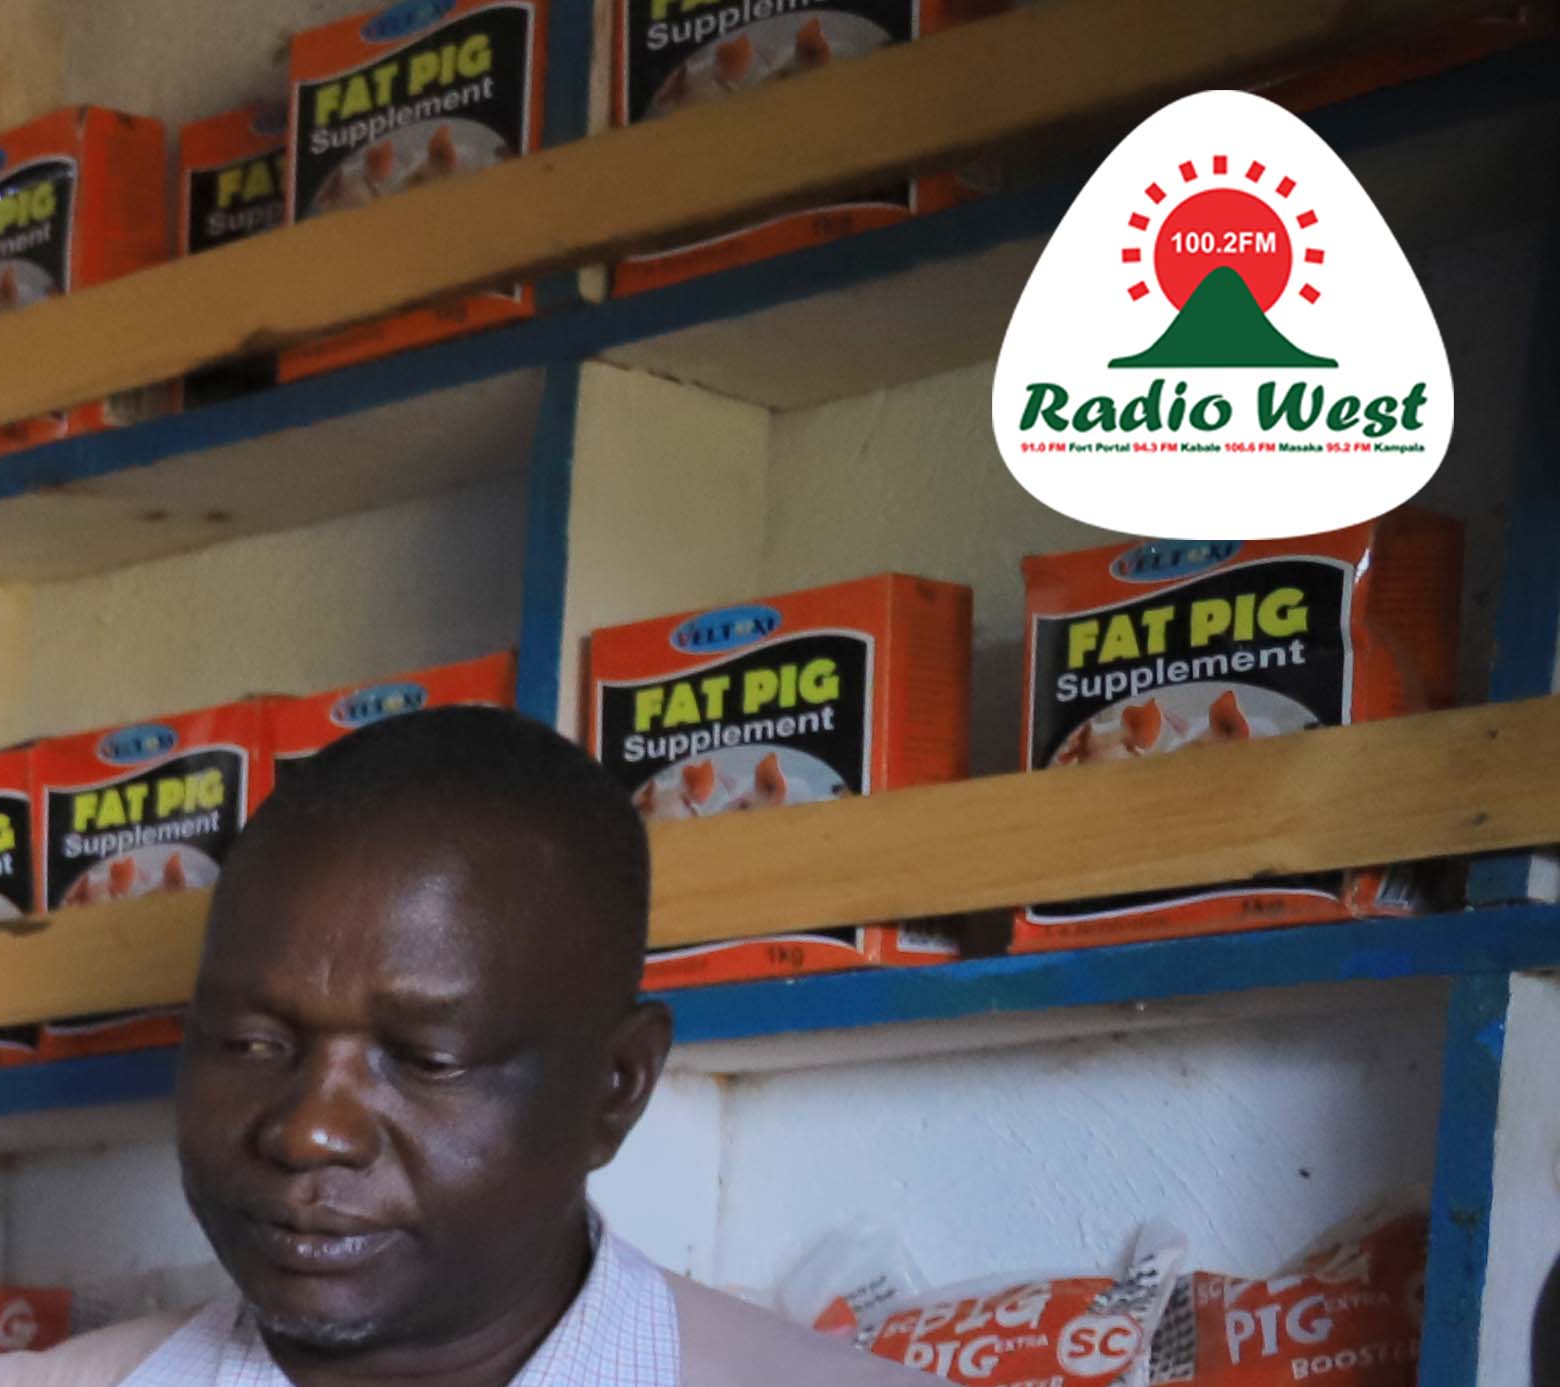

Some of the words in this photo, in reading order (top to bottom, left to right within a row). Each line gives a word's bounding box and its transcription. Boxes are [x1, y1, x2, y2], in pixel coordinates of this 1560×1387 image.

[315, 62, 399, 128] FAT
[407, 33, 493, 97] PIG
[310, 76, 496, 156] Supplement
[1067, 604, 1176, 671] FAT
[1189, 586, 1310, 649] PIG
[633, 674, 732, 734] FAT
[741, 657, 840, 716] PIG
[1056, 639, 1306, 703] Supplement
[622, 705, 836, 763] Supplement
[62, 809, 222, 859] Supplement
[72, 781, 149, 834] FAT
[155, 767, 224, 819] PIG
[1067, 1326, 1132, 1360] SC
[1224, 1294, 1335, 1367] PIG
